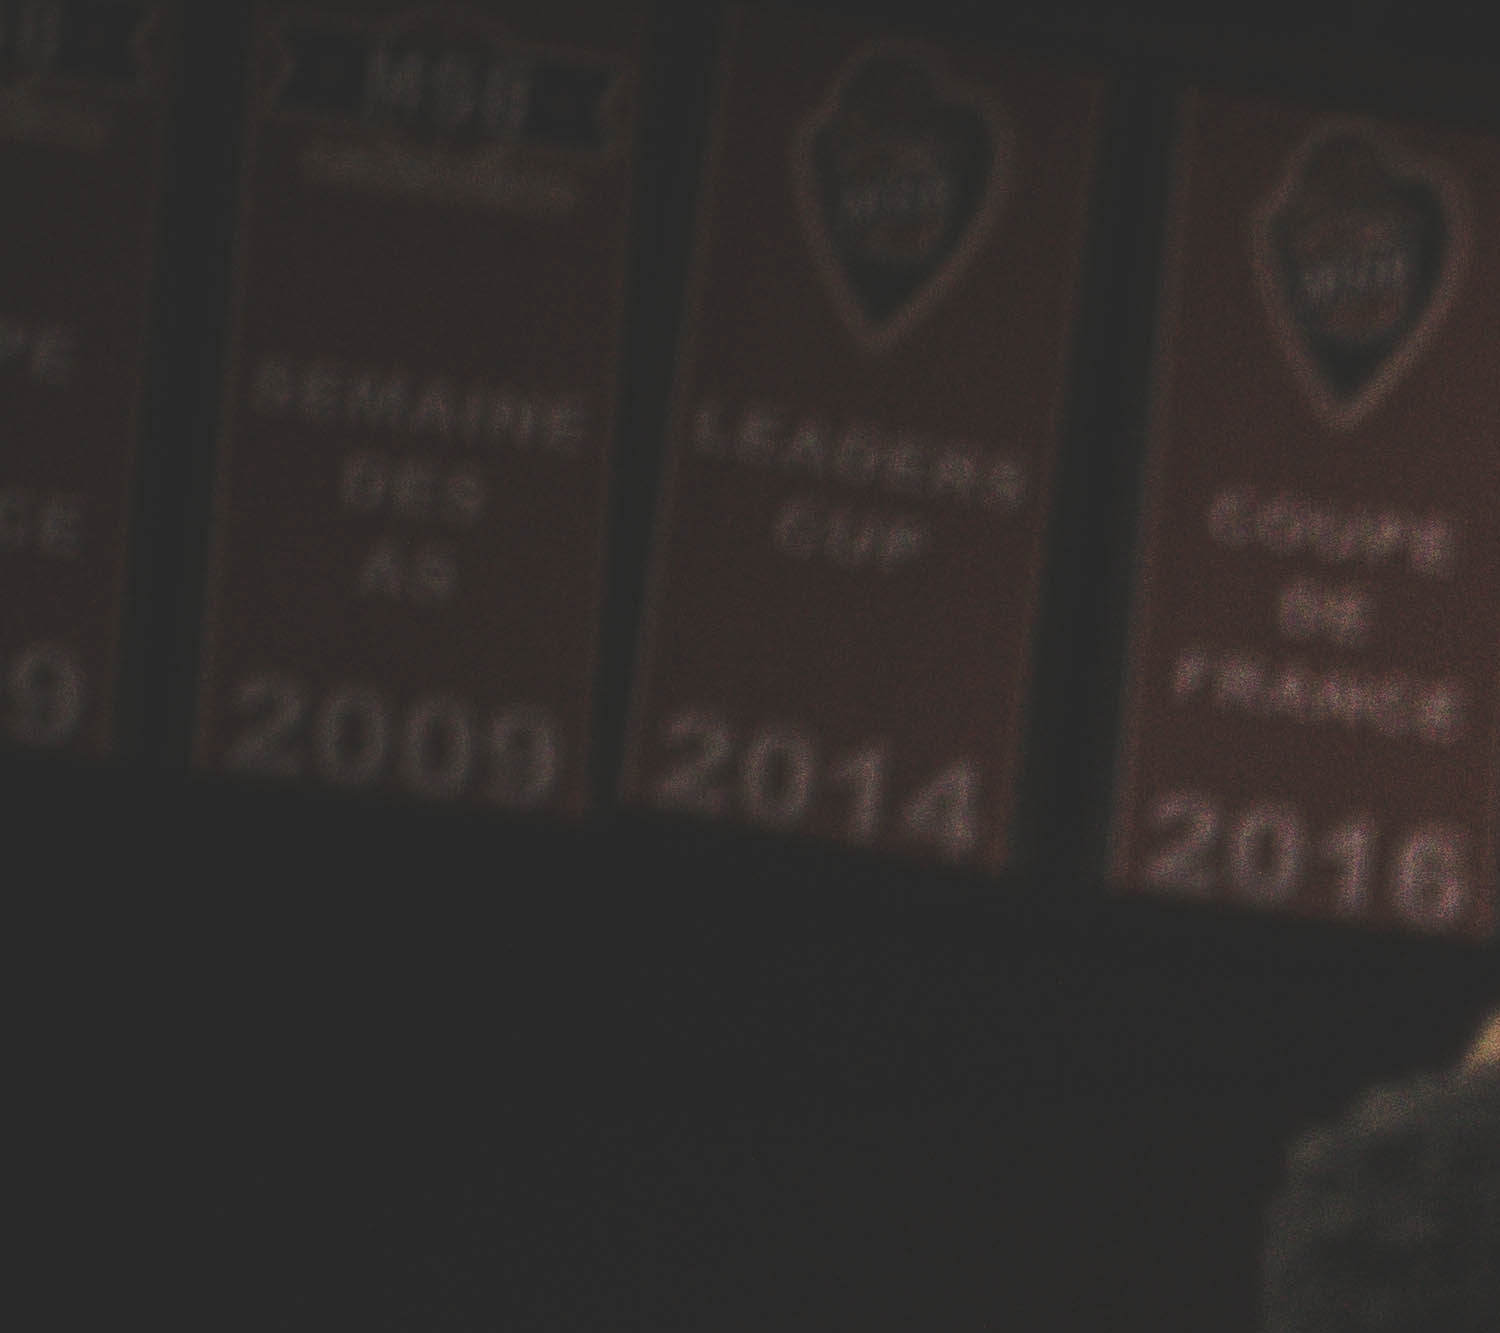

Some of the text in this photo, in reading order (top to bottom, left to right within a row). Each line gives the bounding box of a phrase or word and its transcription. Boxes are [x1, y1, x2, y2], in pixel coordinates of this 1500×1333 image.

[250, 355, 587, 457] SEMAINE
[692, 397, 1030, 513] LEADERS
[773, 492, 931, 577] CUP
[1206, 483, 1456, 578] COUPE
[1277, 578, 1372, 645] DE
[224, 672, 563, 810] 2009
[1170, 647, 1466, 747] FRANCE
[653, 707, 986, 864] 2014
[1142, 788, 1470, 930] 2016
